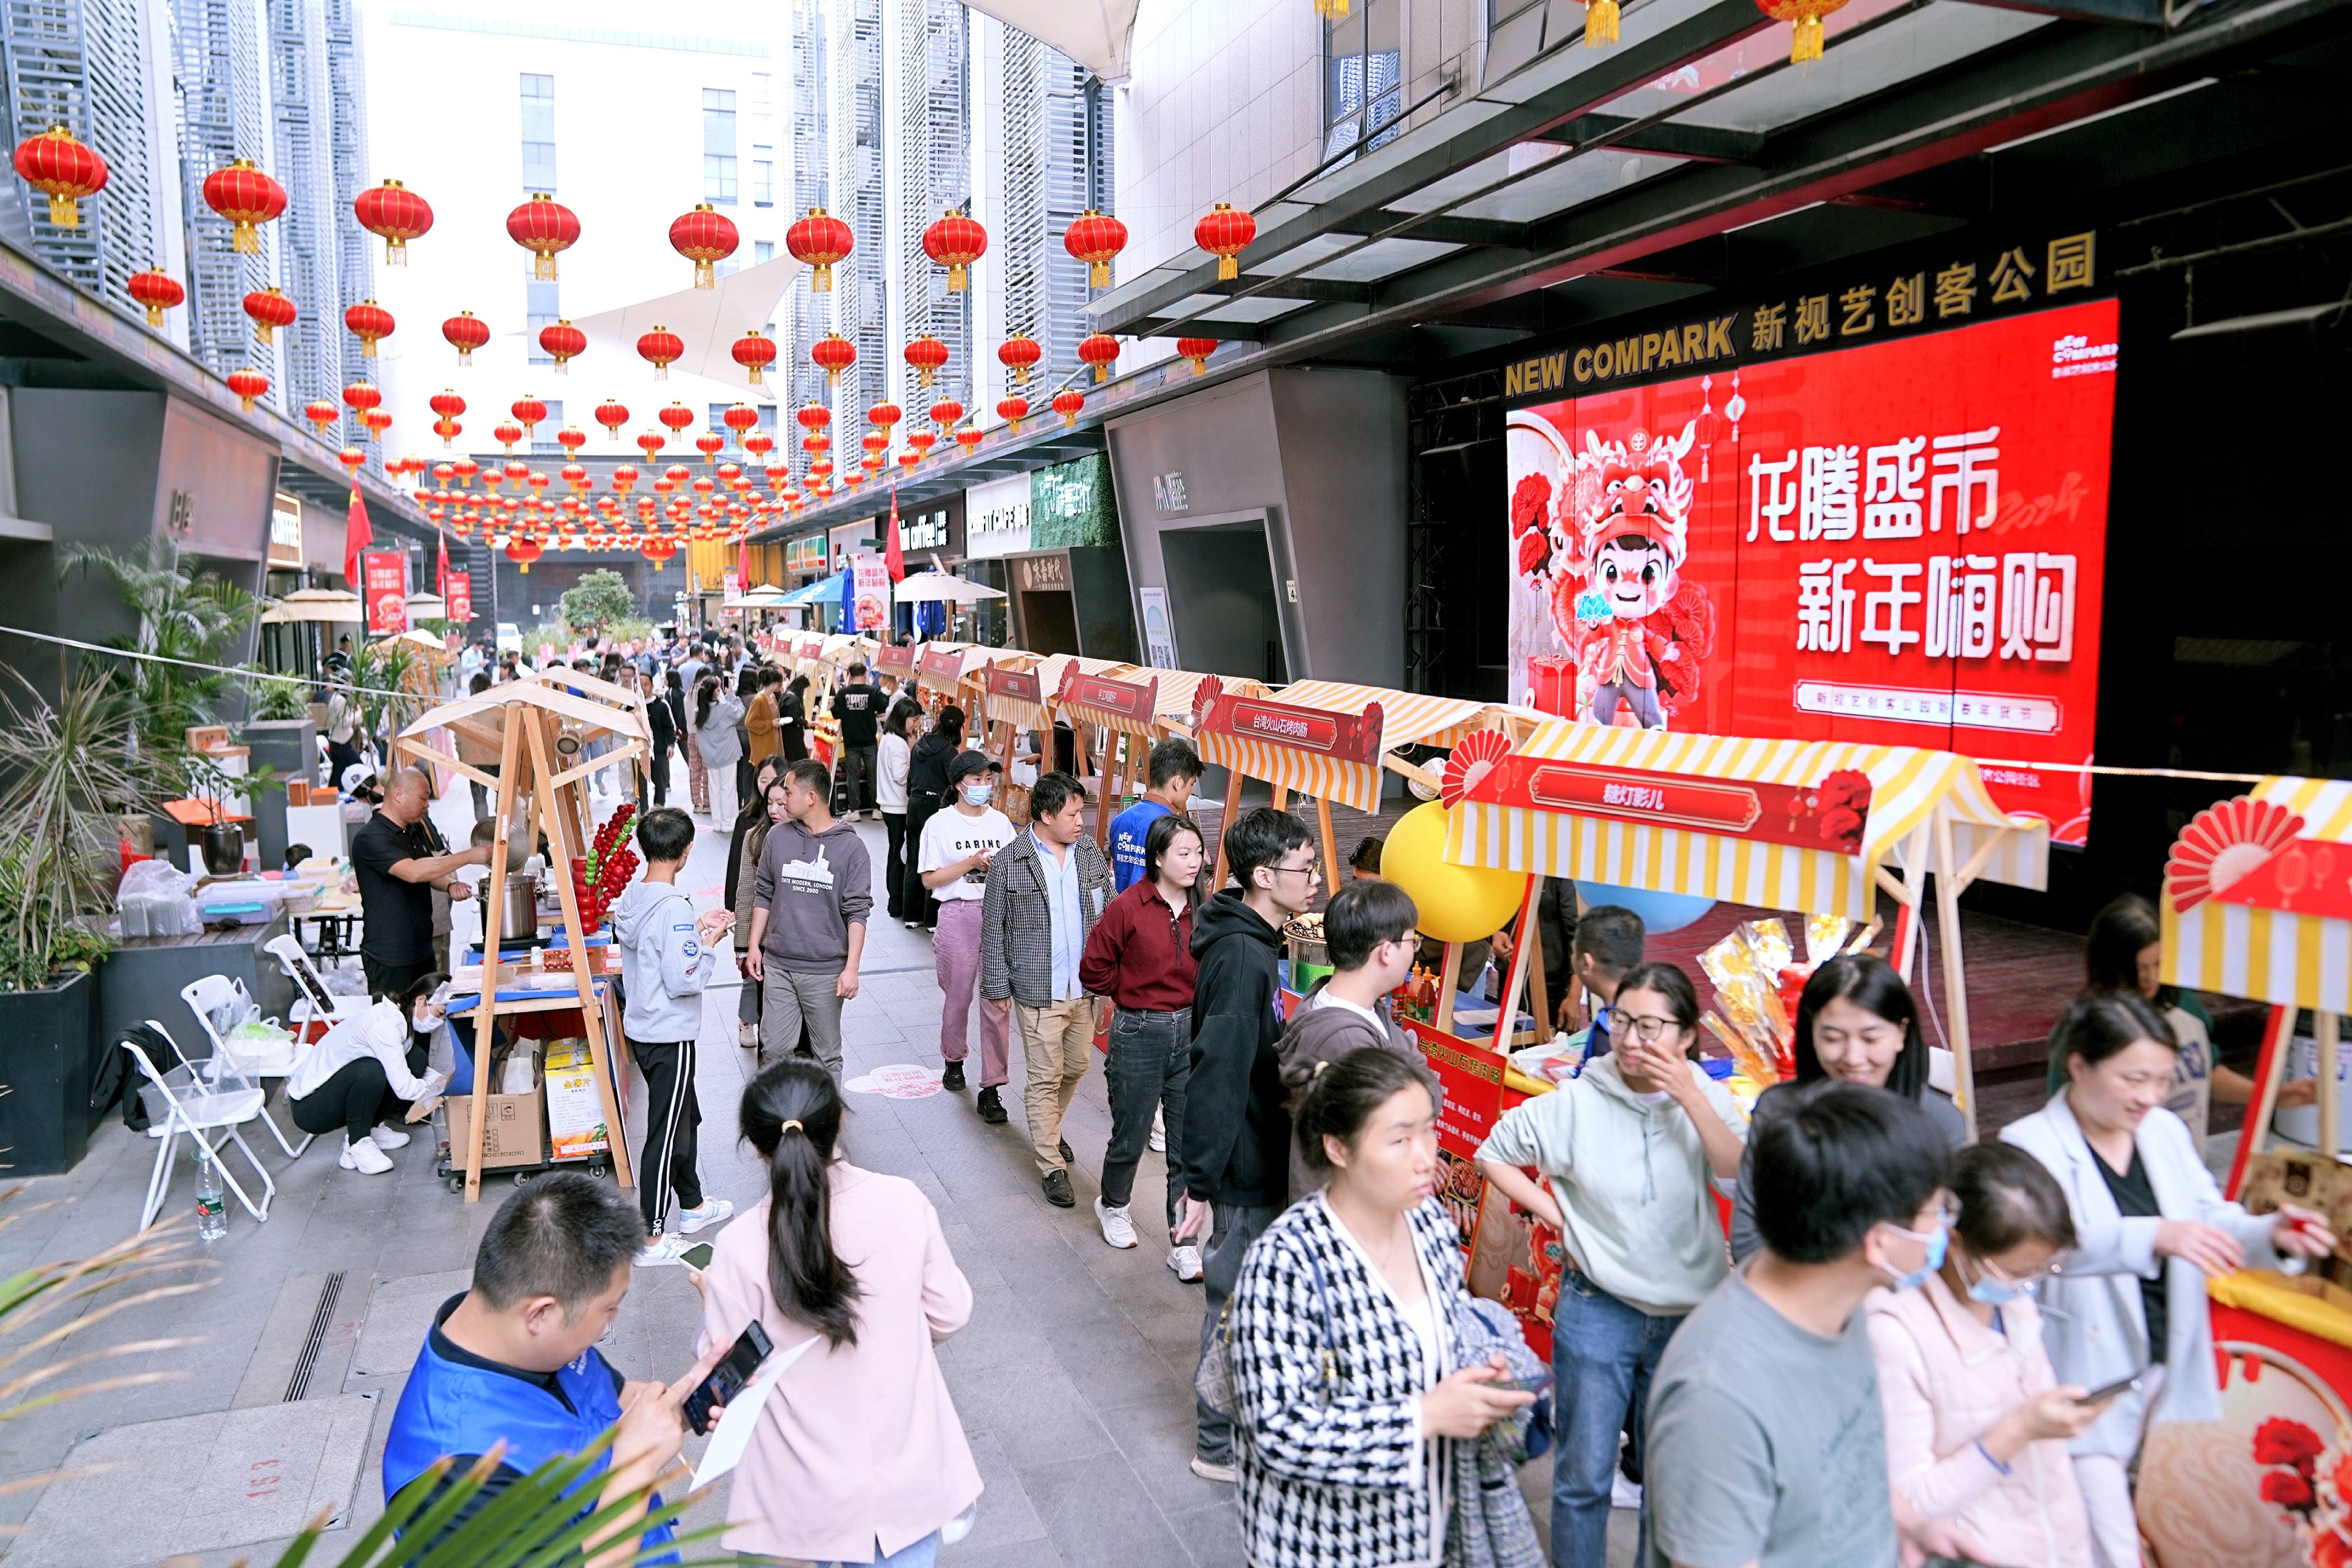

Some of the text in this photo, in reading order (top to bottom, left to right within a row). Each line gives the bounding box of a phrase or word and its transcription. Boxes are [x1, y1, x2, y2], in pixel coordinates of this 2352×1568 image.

[1752, 230, 2095, 352] 新视艺创客公园
[1506, 314, 1738, 397] NEW COMPARK
[1746, 426, 2000, 542] 龙腾盛市
[993, 506, 1015, 530] CAFE
[1994, 472, 2088, 535] 2024
[911, 515, 935, 550] coffee
[1797, 552, 2076, 662] 新年嗨购
[845, 694, 869, 708] SUPPORT
[1254, 713, 1308, 738] 台湾火山石烤肉肠
[955, 839, 1000, 850] CARINO
[1119, 832, 1132, 843] NEW
[791, 879, 812, 887] MODERN,
[1418, 1037, 1501, 1085] 台湾火山石烤肉肠
